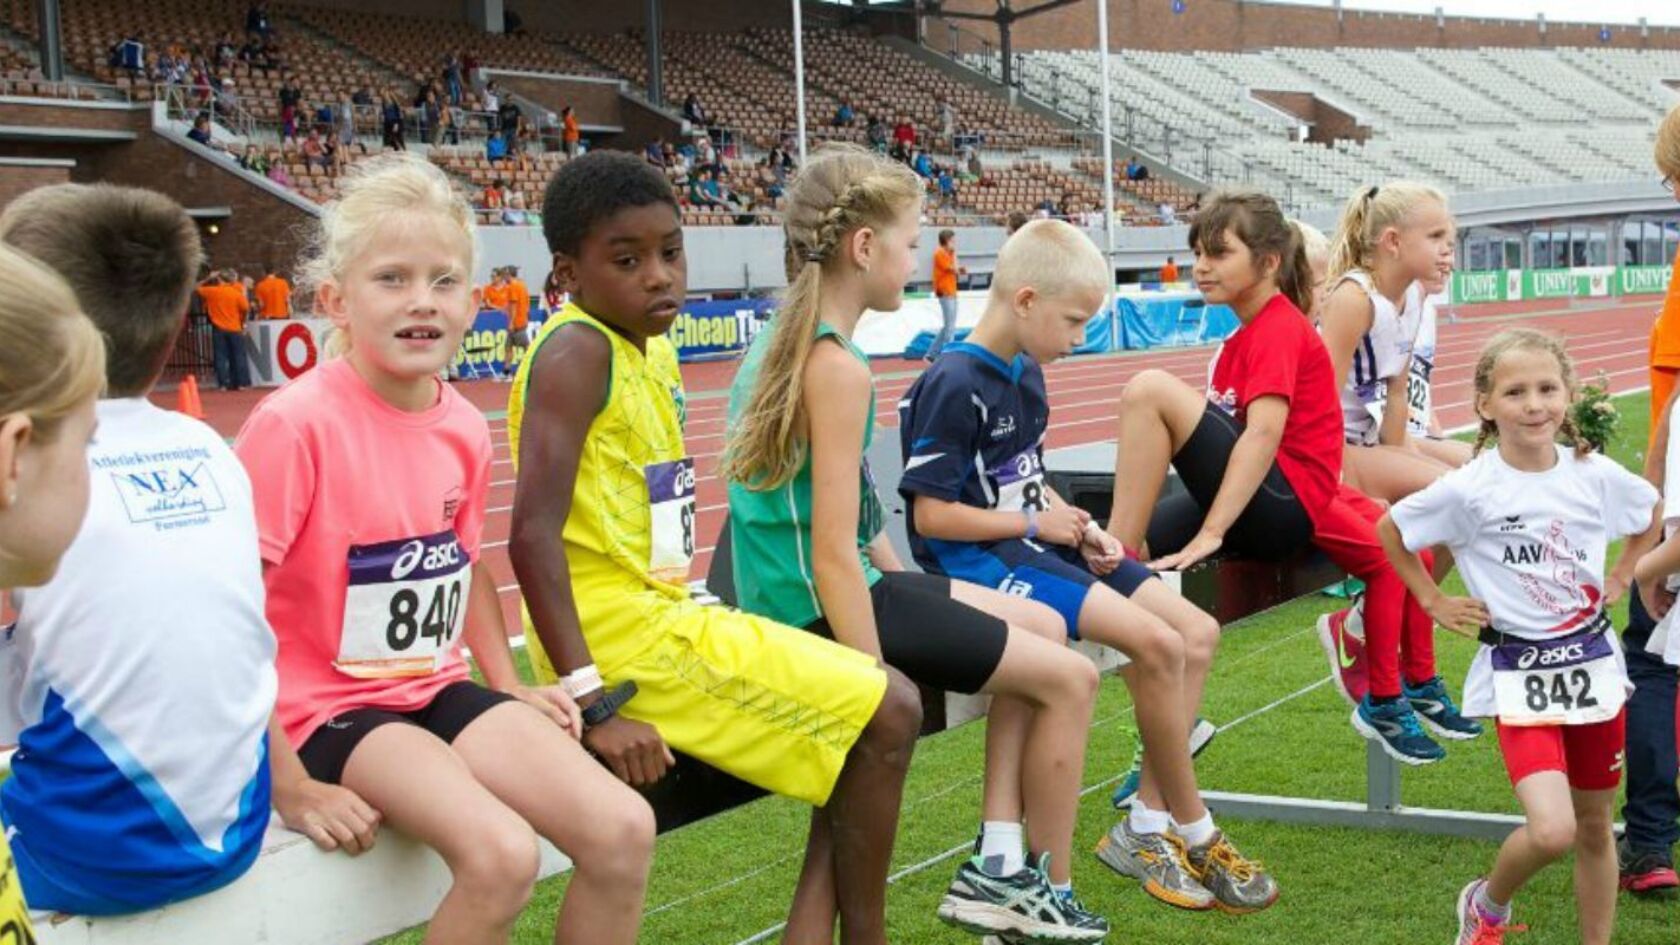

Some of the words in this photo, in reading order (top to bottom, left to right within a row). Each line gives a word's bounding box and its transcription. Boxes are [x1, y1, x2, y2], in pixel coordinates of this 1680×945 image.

[127, 465, 198, 497] NEA
[386, 580, 462, 652] 840
[1539, 643, 1584, 666] asics
[1524, 668, 1598, 712] 842
